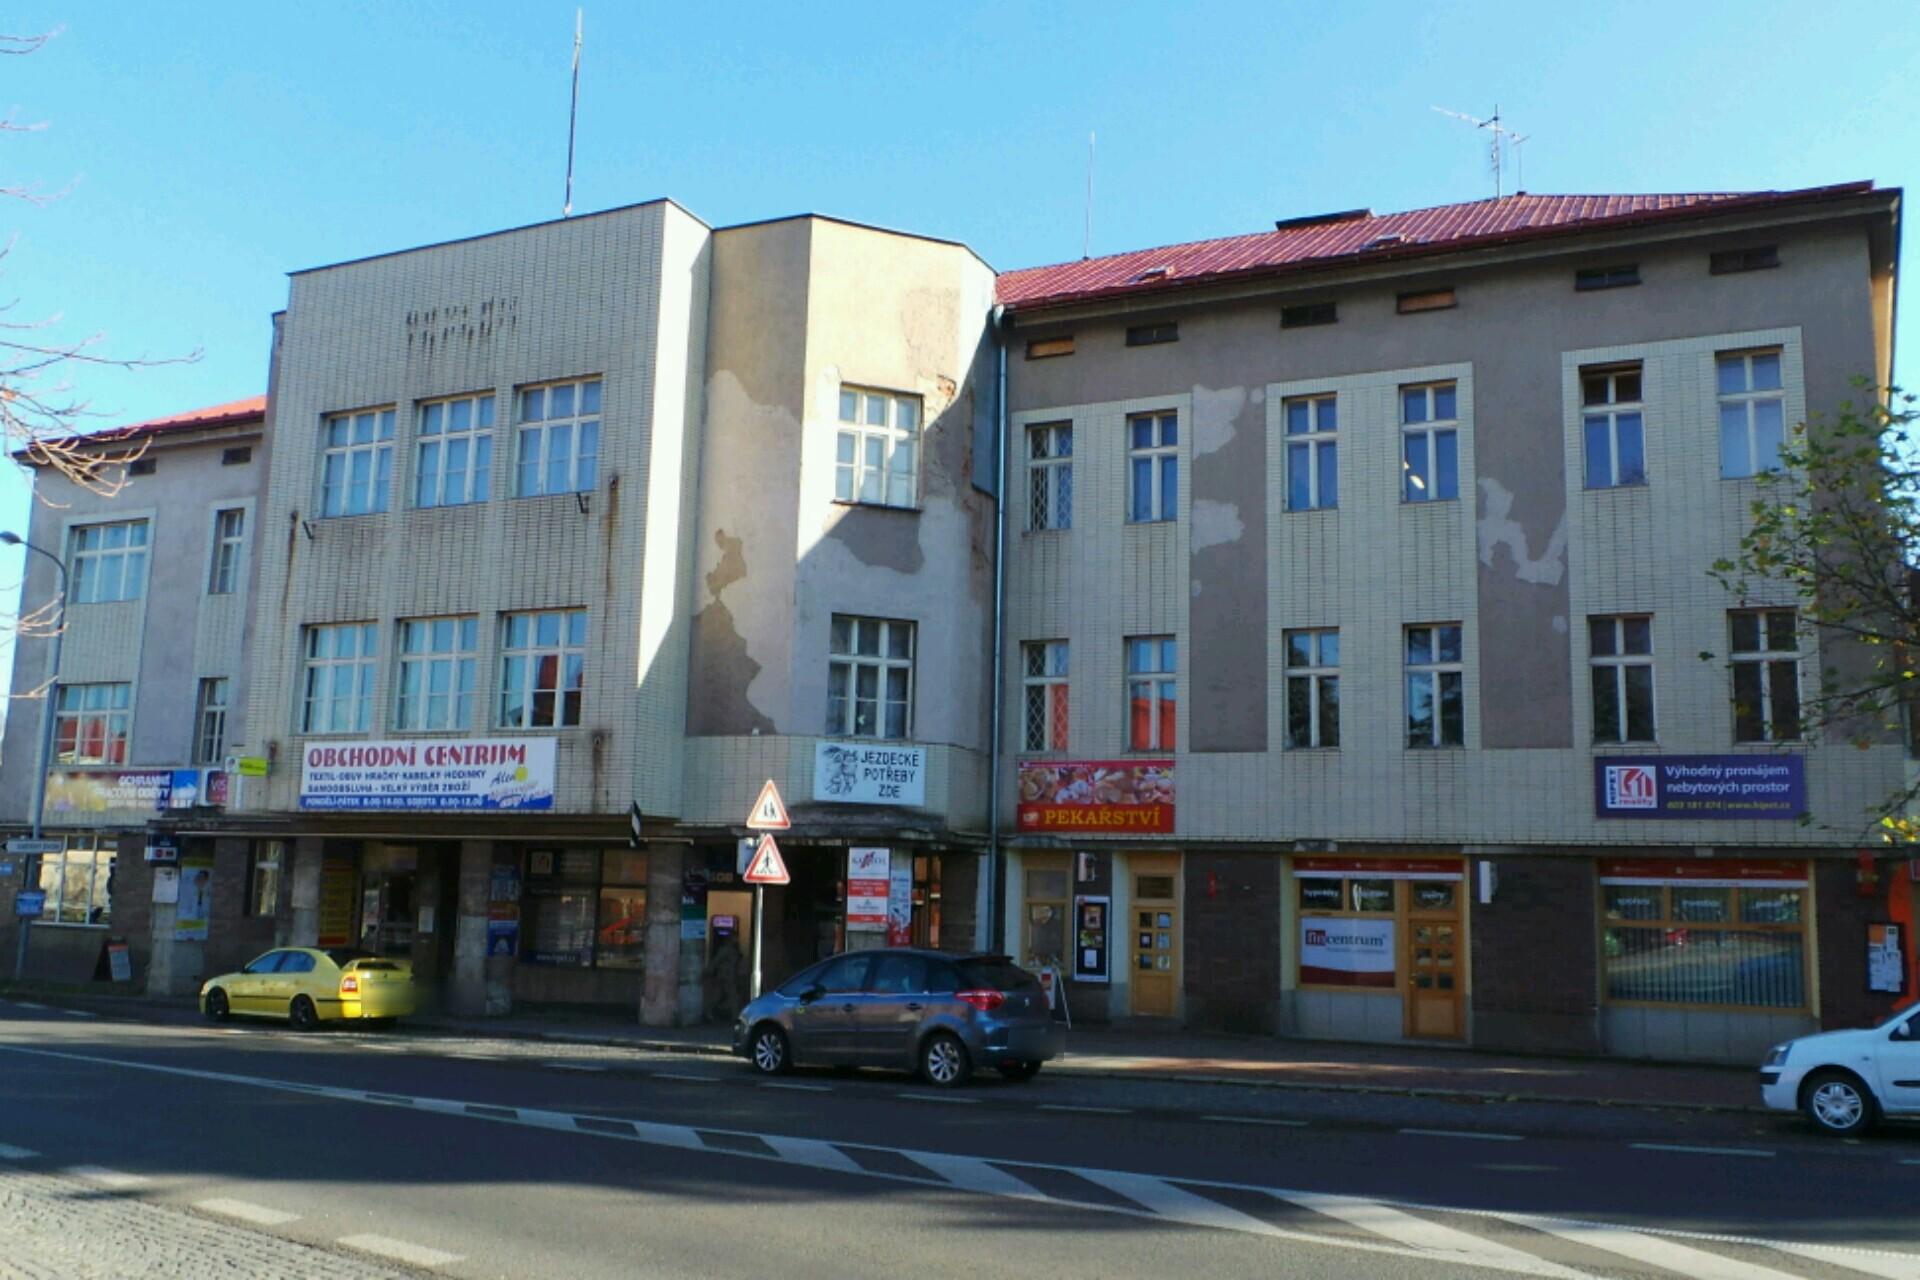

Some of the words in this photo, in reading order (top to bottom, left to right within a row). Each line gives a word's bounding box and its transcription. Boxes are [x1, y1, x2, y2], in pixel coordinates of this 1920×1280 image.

[307, 742, 417, 768] OBCHODNÍ
[424, 743, 527, 766] CENTRUM
[860, 751, 920, 767] JEZDECKÉ
[864, 766, 916, 783] POTŘEBY
[1665, 765, 1722, 779] Výhodný
[1725, 765, 1789, 779] pronájem
[380, 782, 408, 793] VELKÝ
[410, 781, 439, 792] VÝBĚR
[442, 781, 471, 792] ZBOŽÍ
[878, 783, 901, 798] ZDE
[1666, 781, 1740, 795] nebytových
[1742, 783, 1790, 795] prostor
[1043, 806, 1161, 826] PEKAŘSTVÍ
